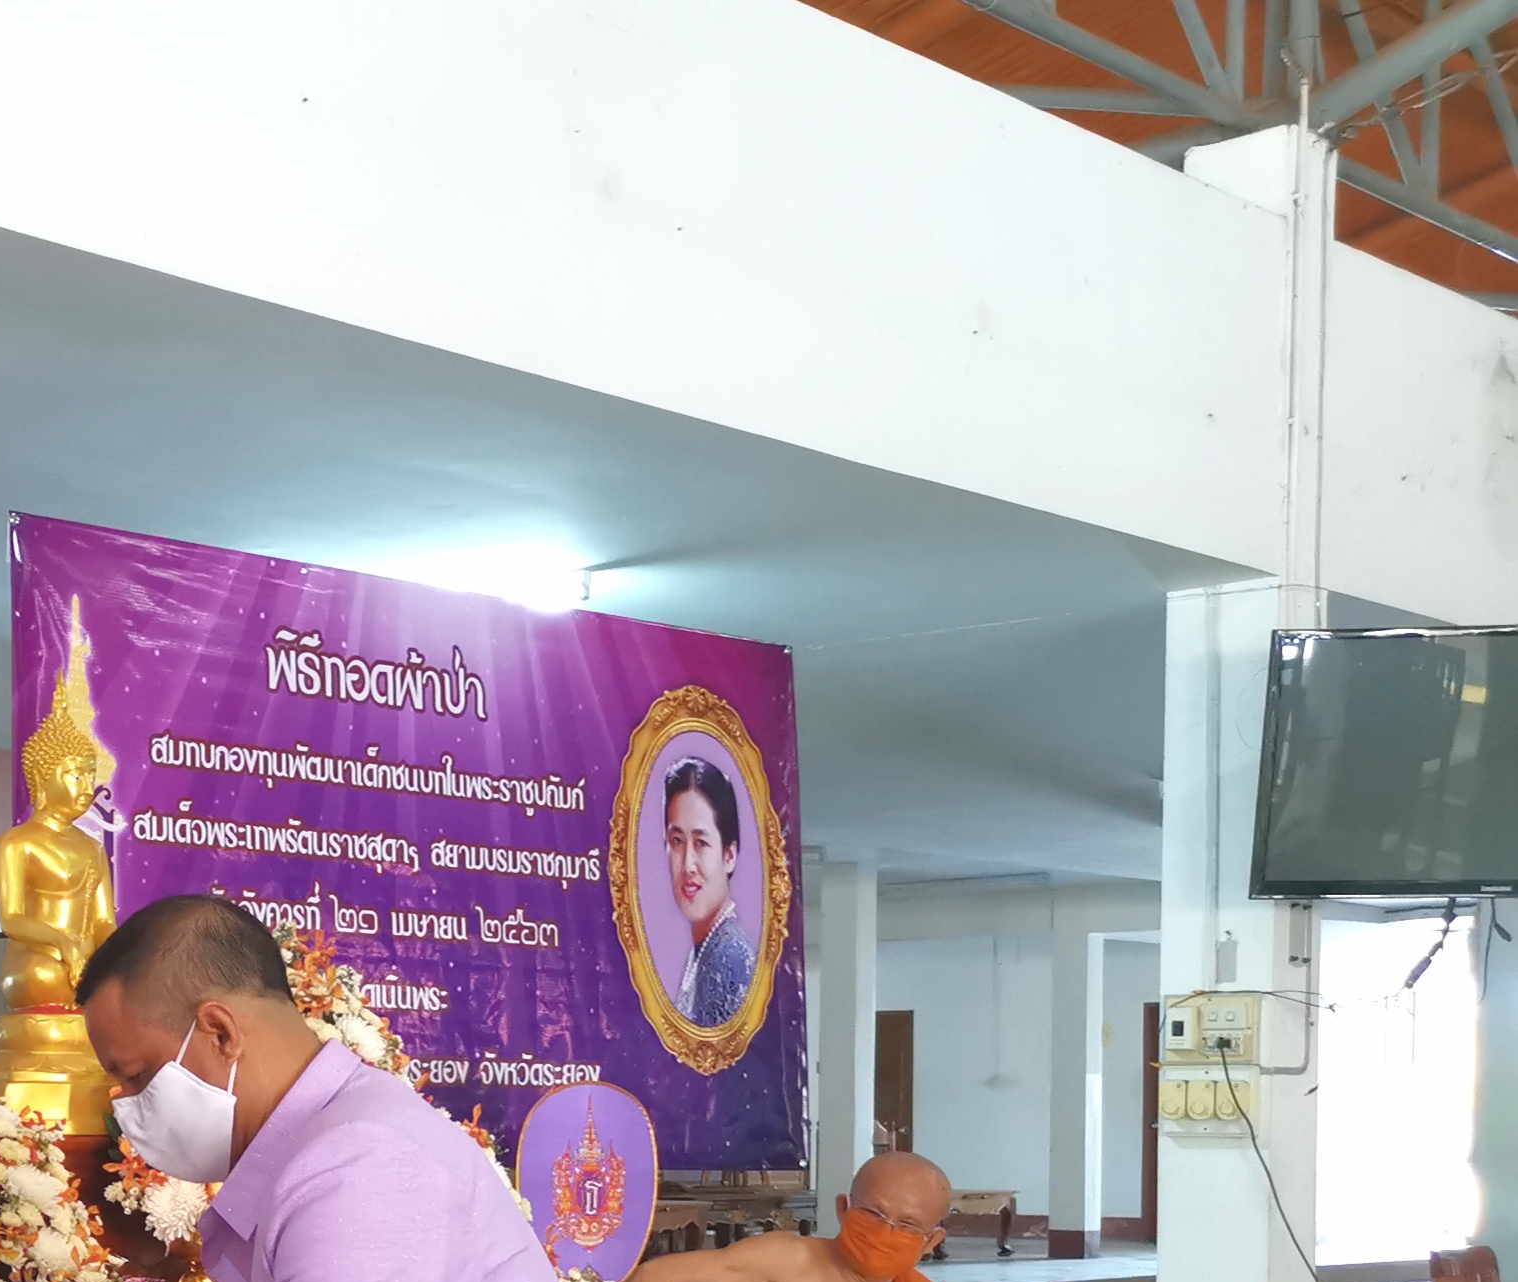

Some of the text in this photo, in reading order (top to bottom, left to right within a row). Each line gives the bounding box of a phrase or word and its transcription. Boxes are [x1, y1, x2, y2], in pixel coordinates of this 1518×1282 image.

[266, 629, 487, 719] พิธีทอดผ้าป่า
[150, 734, 585, 817] สมทบกองทุนพัฒนาเด็กชนบทในพระราชูปถัมภ์
[133, 801, 601, 890] สมเด็จพระเทพรัตนราชสุดาฯ สยามบรมราชกุมารี
[329, 894, 379, 934] ๒๑
[390, 908, 468, 941] เมษายน
[474, 906, 559, 947] ๒๕๖๓
[360, 975, 449, 1011] ดเนินพระ
[480, 1051, 602, 1088] จังหวัดระยอง
